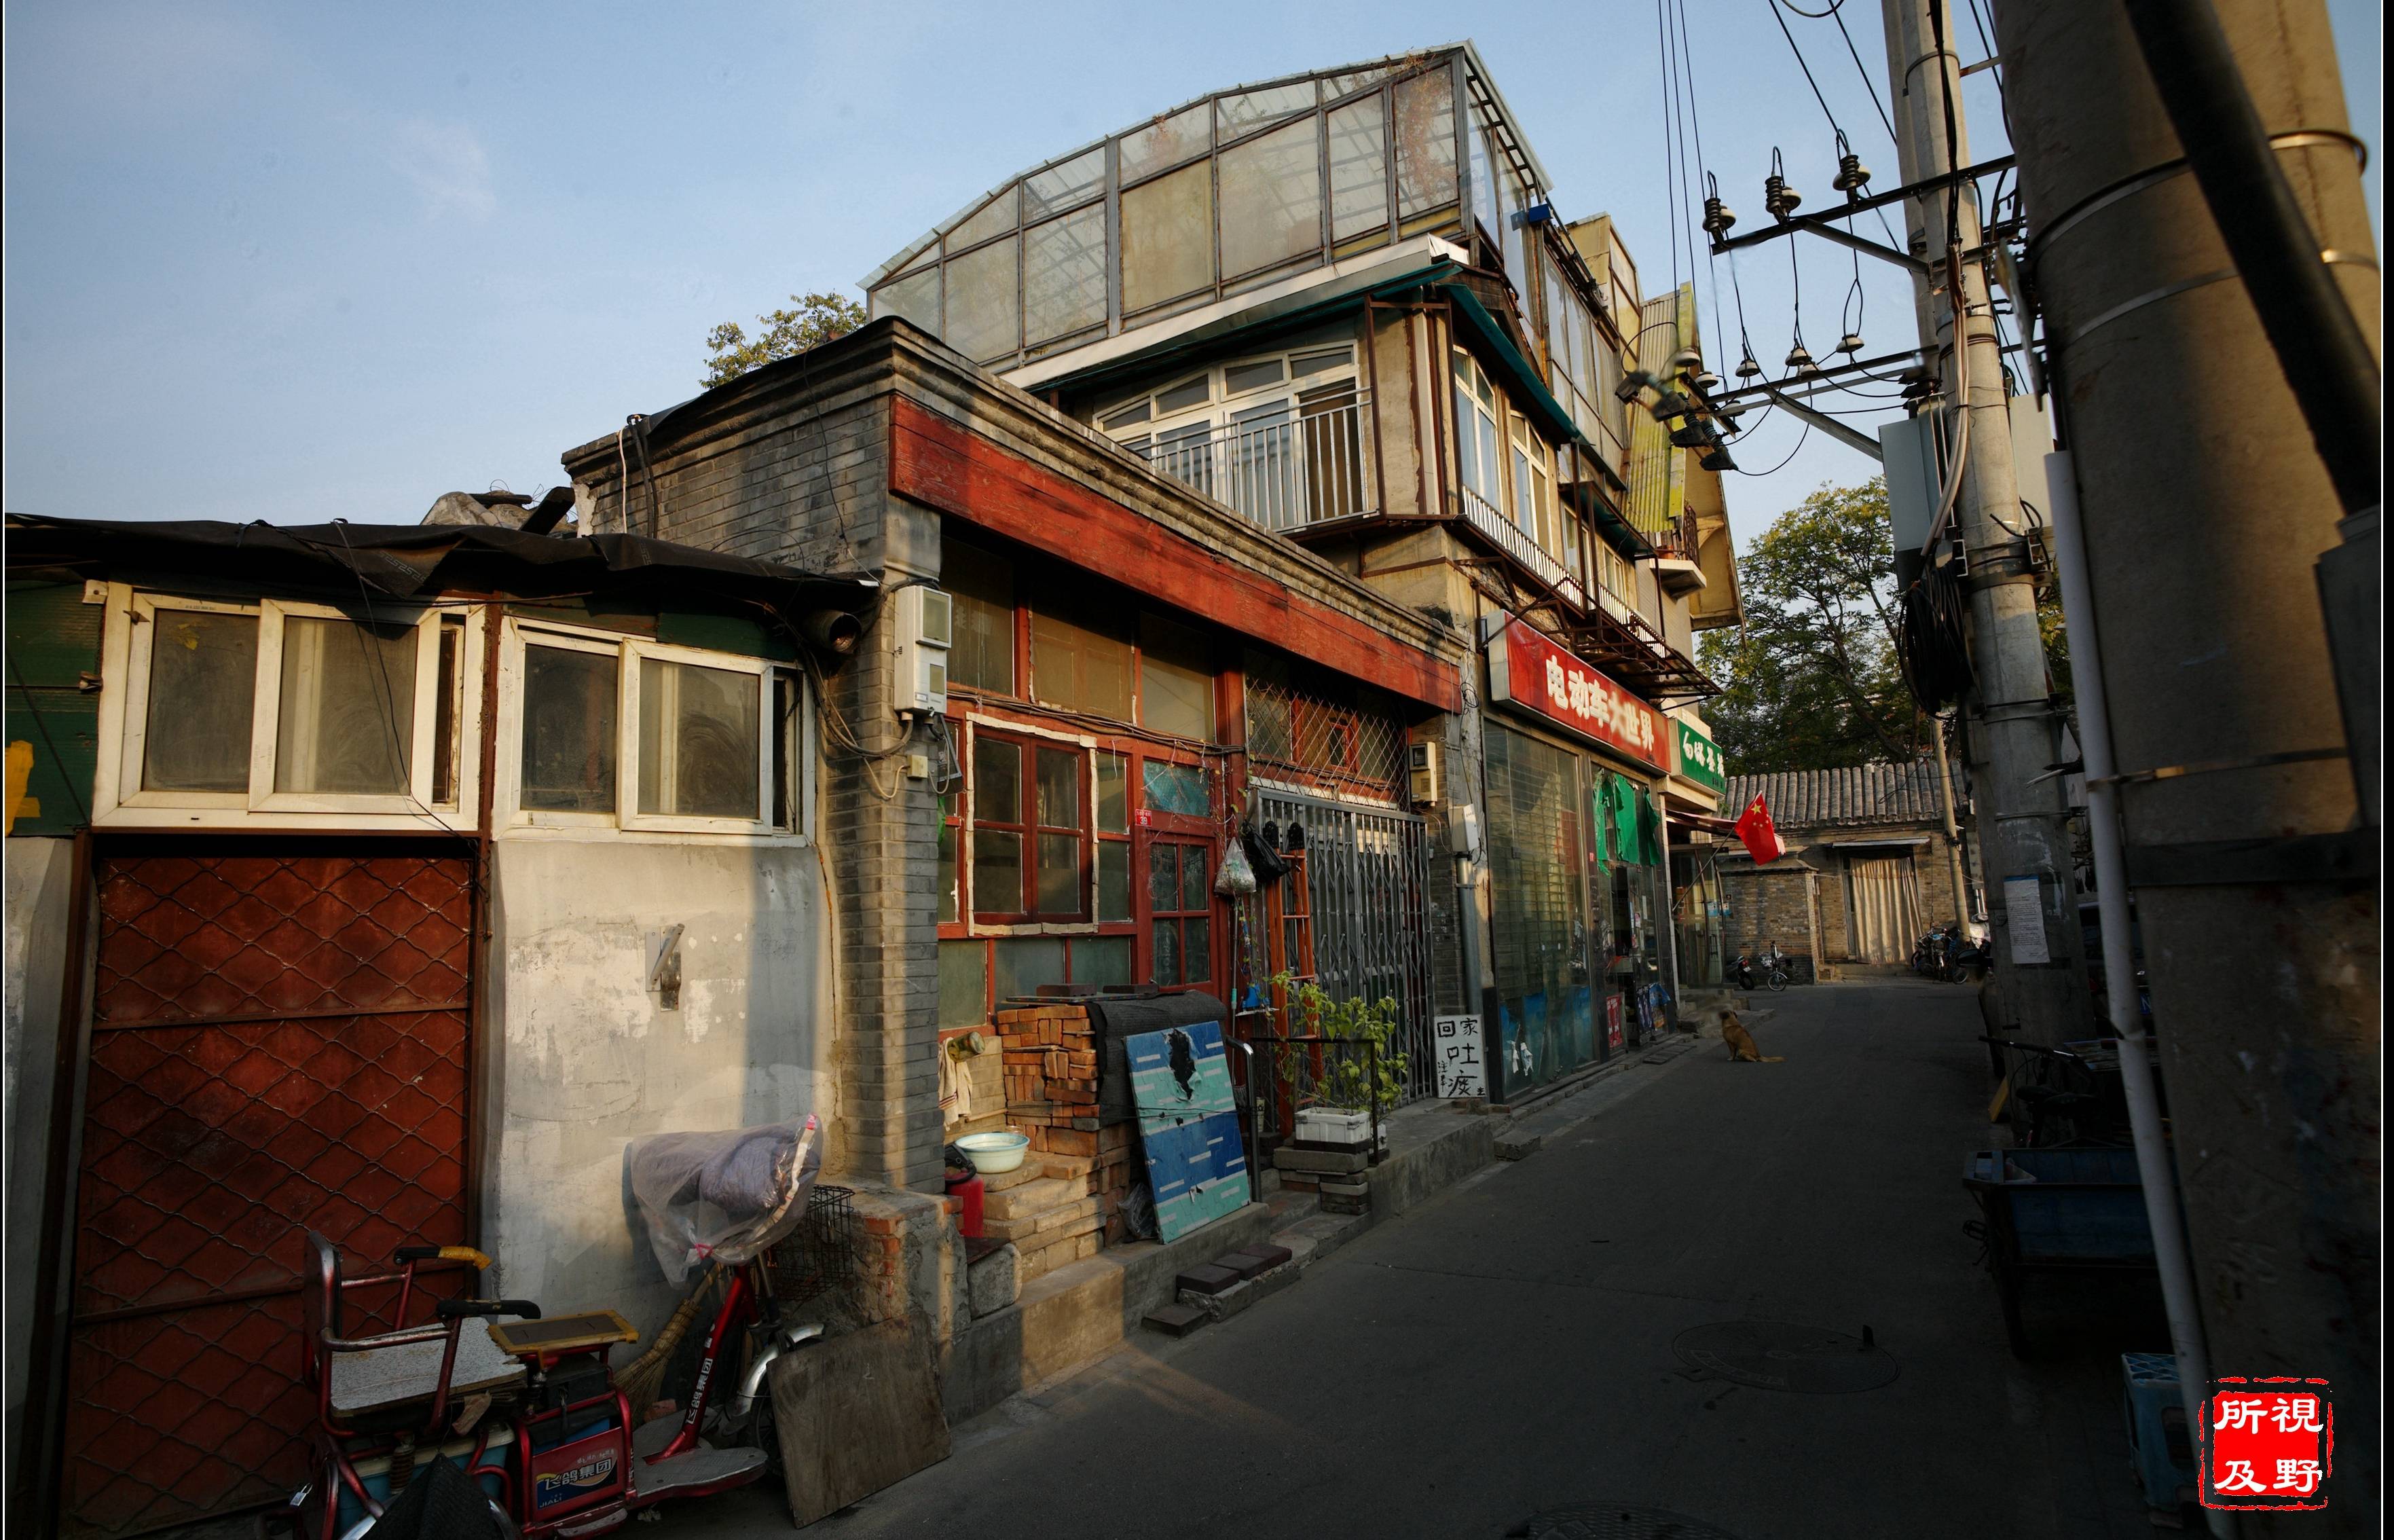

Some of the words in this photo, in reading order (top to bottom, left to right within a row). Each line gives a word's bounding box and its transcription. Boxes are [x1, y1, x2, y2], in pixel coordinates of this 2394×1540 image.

[1545, 654, 1655, 752] 电动车大世界
[1437, 1017, 1478, 1038] 回家
[686, 1357, 714, 1425] 飞鸽集团
[545, 1457, 612, 1491] 飞鸽集团
